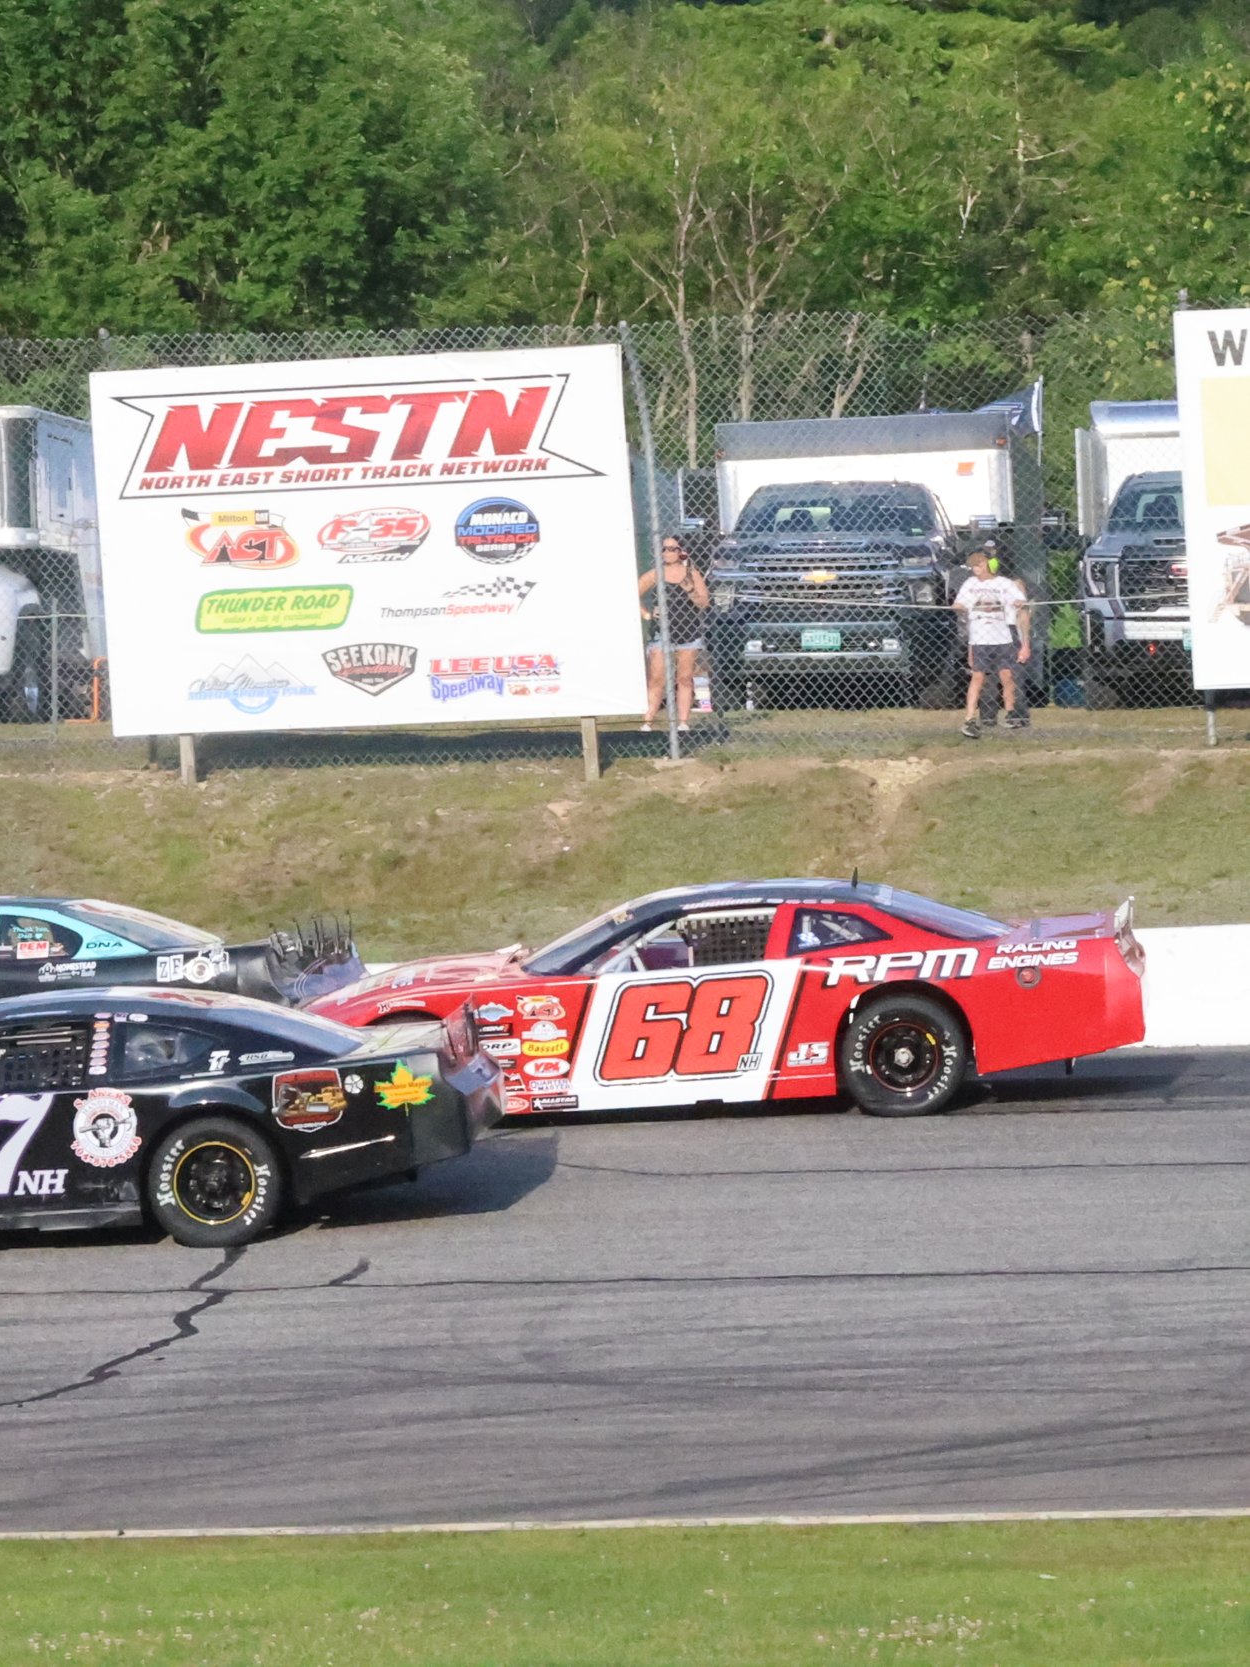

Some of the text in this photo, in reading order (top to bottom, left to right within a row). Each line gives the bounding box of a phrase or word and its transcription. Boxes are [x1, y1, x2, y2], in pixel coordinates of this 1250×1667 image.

[144, 385, 552, 474] NESTN
[138, 457, 552, 491] NORTH EAST SHORT TRACK NETWORK
[457, 523, 538, 536] MODIFIED
[470, 511, 529, 526] MONACO
[202, 529, 289, 564] ACT
[459, 533, 537, 546] TRI-TRACK
[475, 543, 517, 552] SERIES
[342, 552, 410, 564] NORTH
[207, 593, 341, 615] THUNDER ROAD
[325, 643, 416, 672] SEEKONK
[430, 654, 560, 675] LEE USA
[430, 674, 506, 702] Speedway
[19, 942, 48, 951] PEM
[996, 939, 1078, 955] RACING
[825, 946, 981, 988] RPM
[987, 951, 1079, 970] ENGINES
[600, 974, 770, 1081] 68
[527, 1042, 564, 1054] Bassett
[849, 1015, 881, 1073] Hoosier
[739, 1054, 760, 1069] NH
[927, 1044, 958, 1100] Hoosier
[14, 1168, 70, 1196] NH
[156, 1139, 185, 1207] Hoosier
[243, 1163, 271, 1226] Hoosier
